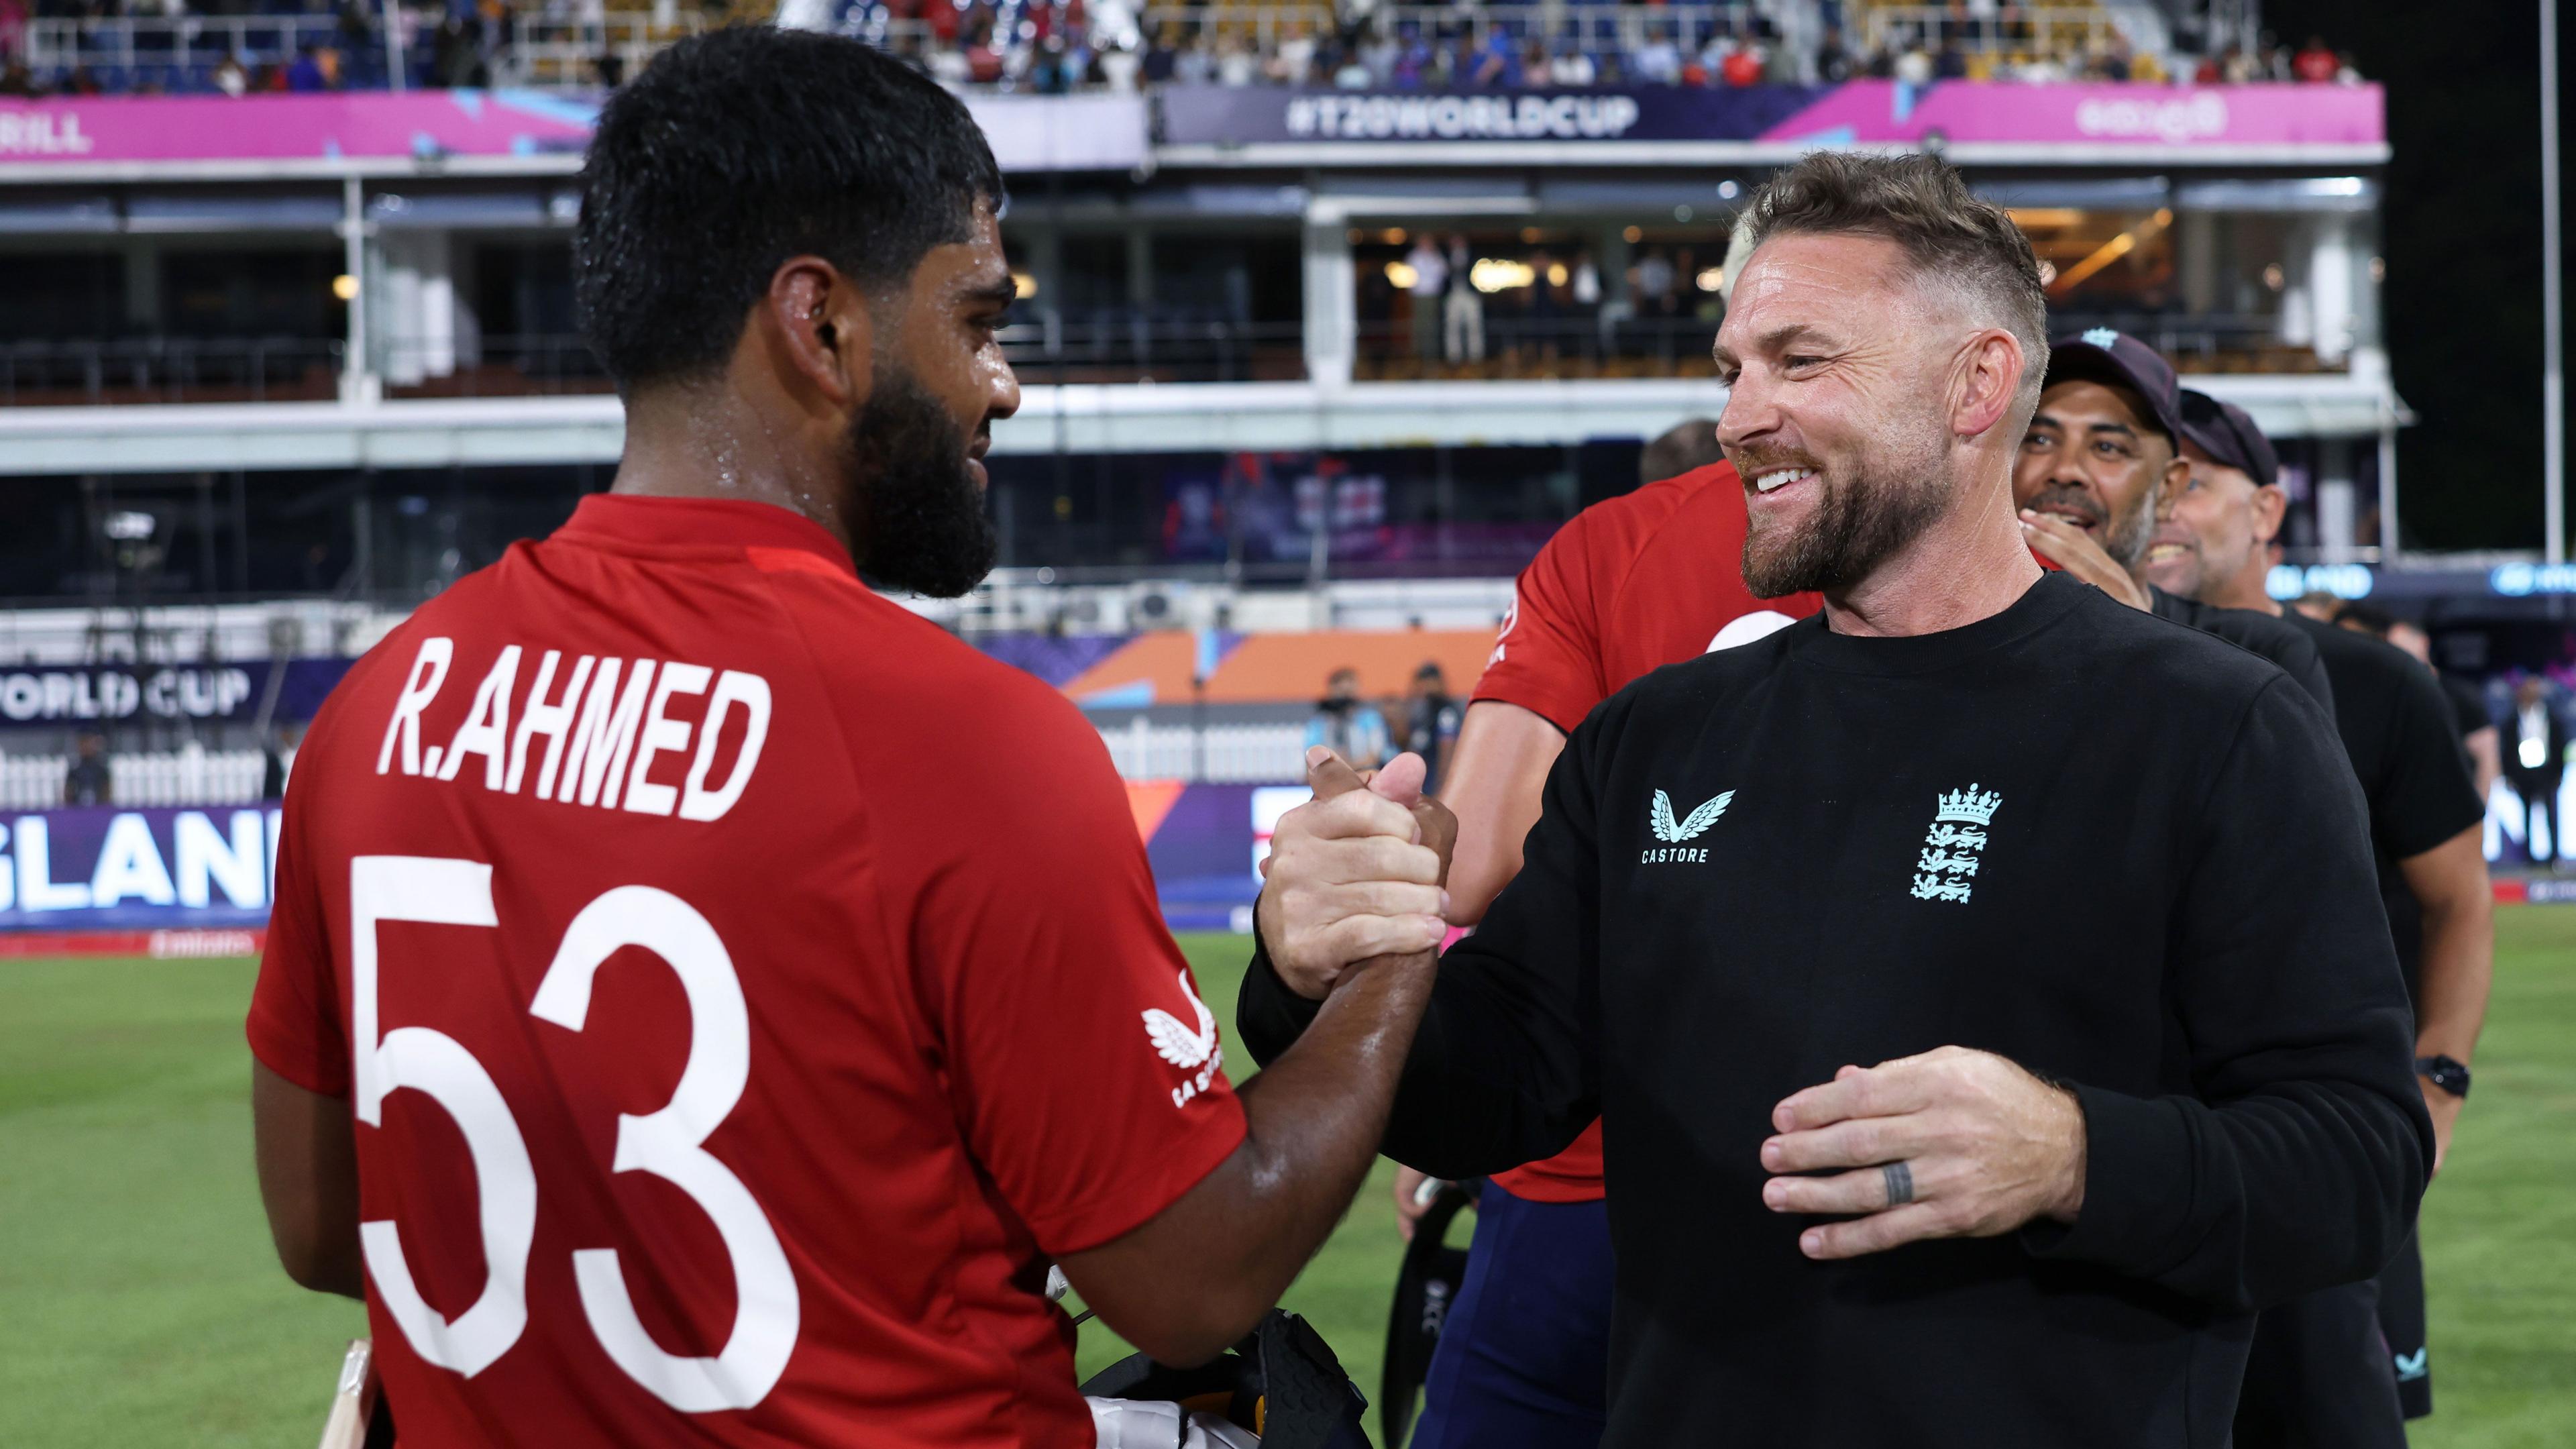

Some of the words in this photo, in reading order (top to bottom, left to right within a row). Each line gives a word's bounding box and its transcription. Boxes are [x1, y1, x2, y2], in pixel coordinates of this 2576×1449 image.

[1287, 96, 1638, 138] #T20WORLDCUP
[0, 671, 140, 720] ORLD
[144, 668, 251, 718] CUP
[376, 637, 771, 822] R.AHMED
[0, 810, 282, 912] LAN
[1642, 848, 1709, 864] CASTORE
[351, 855, 800, 1413] 53
